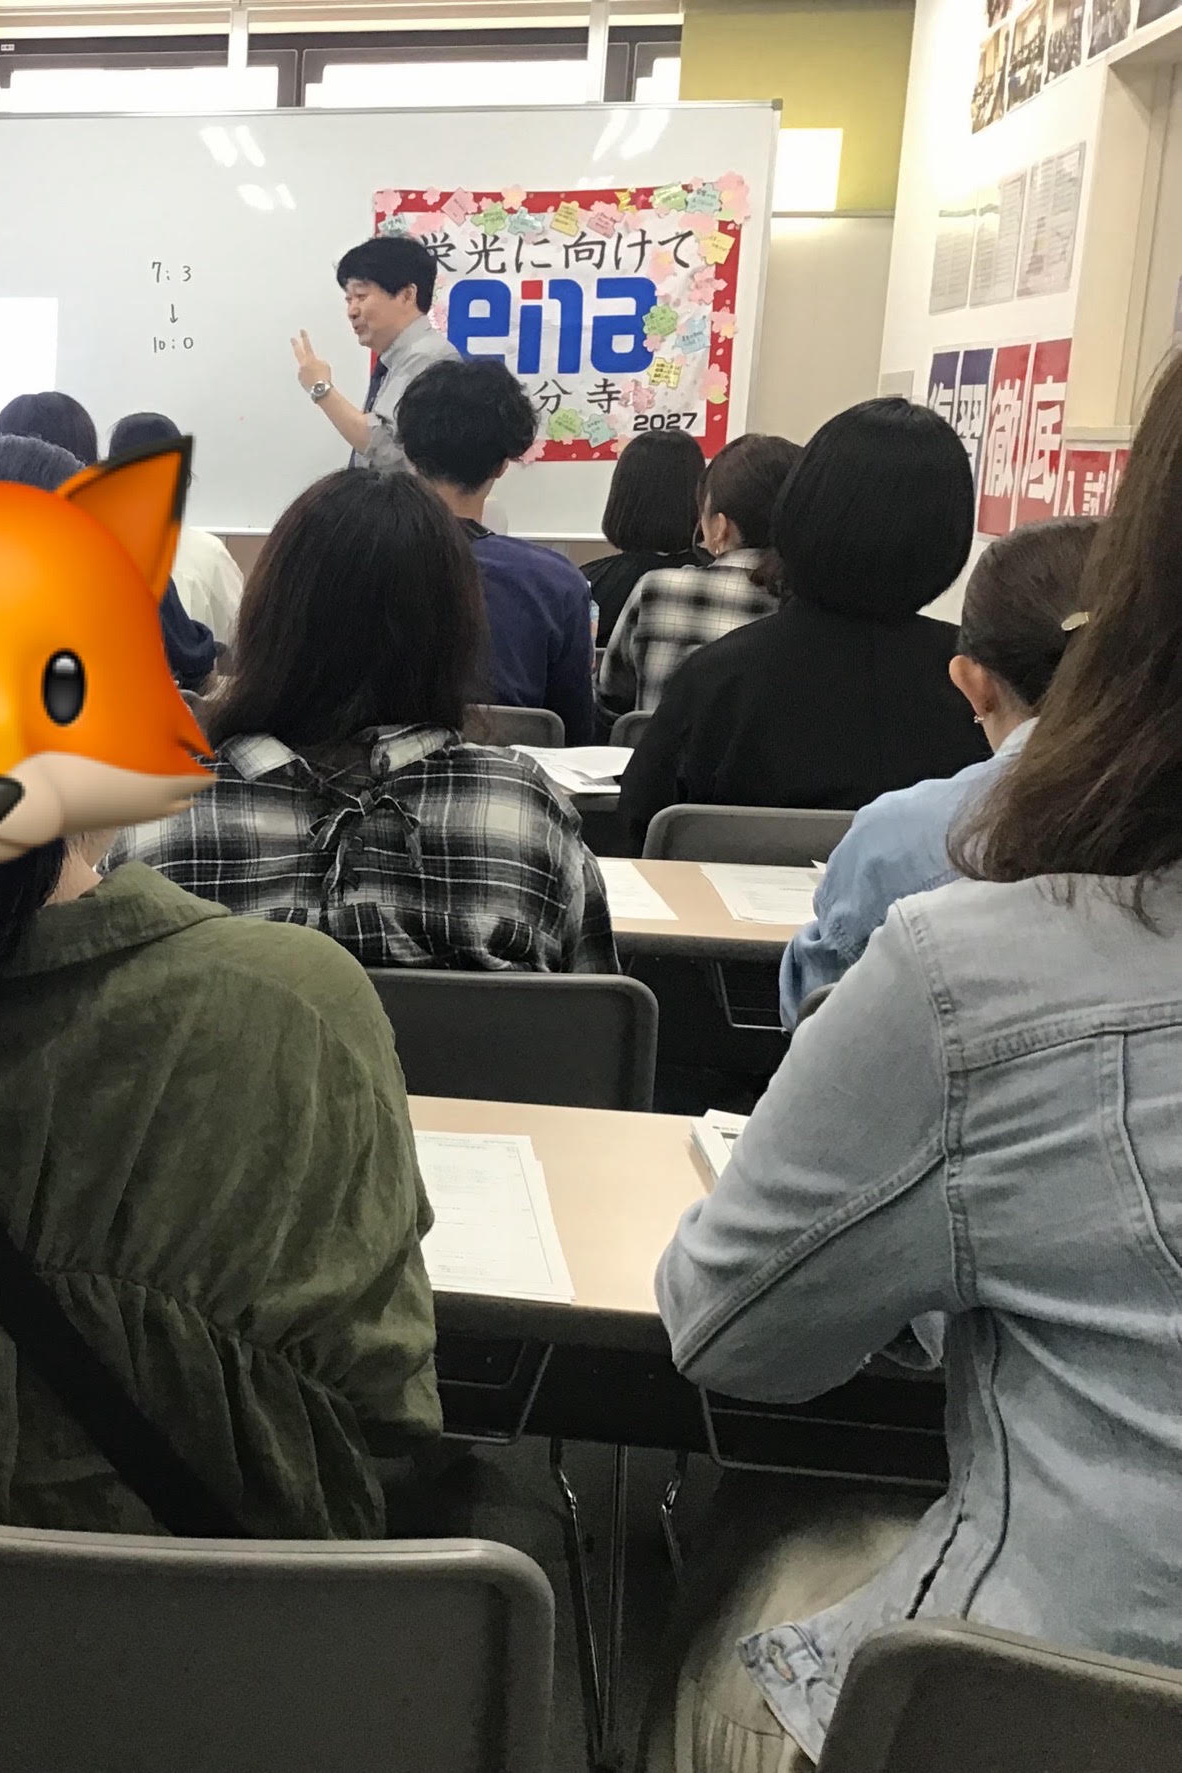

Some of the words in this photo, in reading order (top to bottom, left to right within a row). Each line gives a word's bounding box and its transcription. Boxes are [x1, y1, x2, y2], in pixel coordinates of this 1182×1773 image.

[420, 229, 694, 274] 栄光に向けて
[447, 277, 658, 374] ena
[633, 413, 698, 431] 2027
